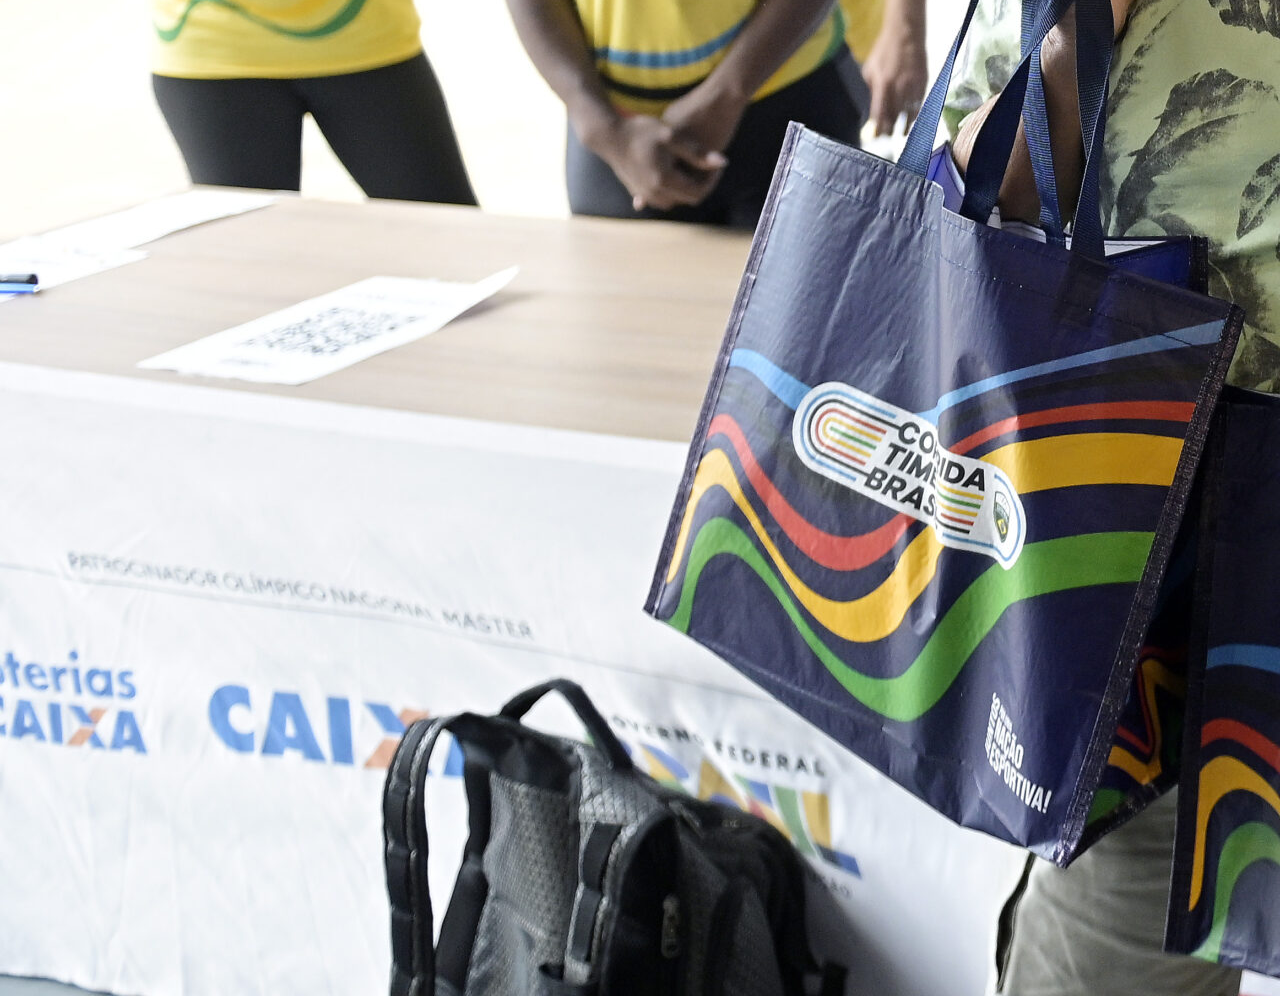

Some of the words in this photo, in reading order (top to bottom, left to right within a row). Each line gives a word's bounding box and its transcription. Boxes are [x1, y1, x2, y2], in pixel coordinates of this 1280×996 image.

[864, 466, 937, 518] BRAS
[442, 609, 534, 640] MASTER
[0, 650, 137, 700] terias
[0, 699, 148, 755] AIXA
[714, 738, 826, 778] FEDERAL
[988, 741, 1053, 814] ESPORTIVA!
